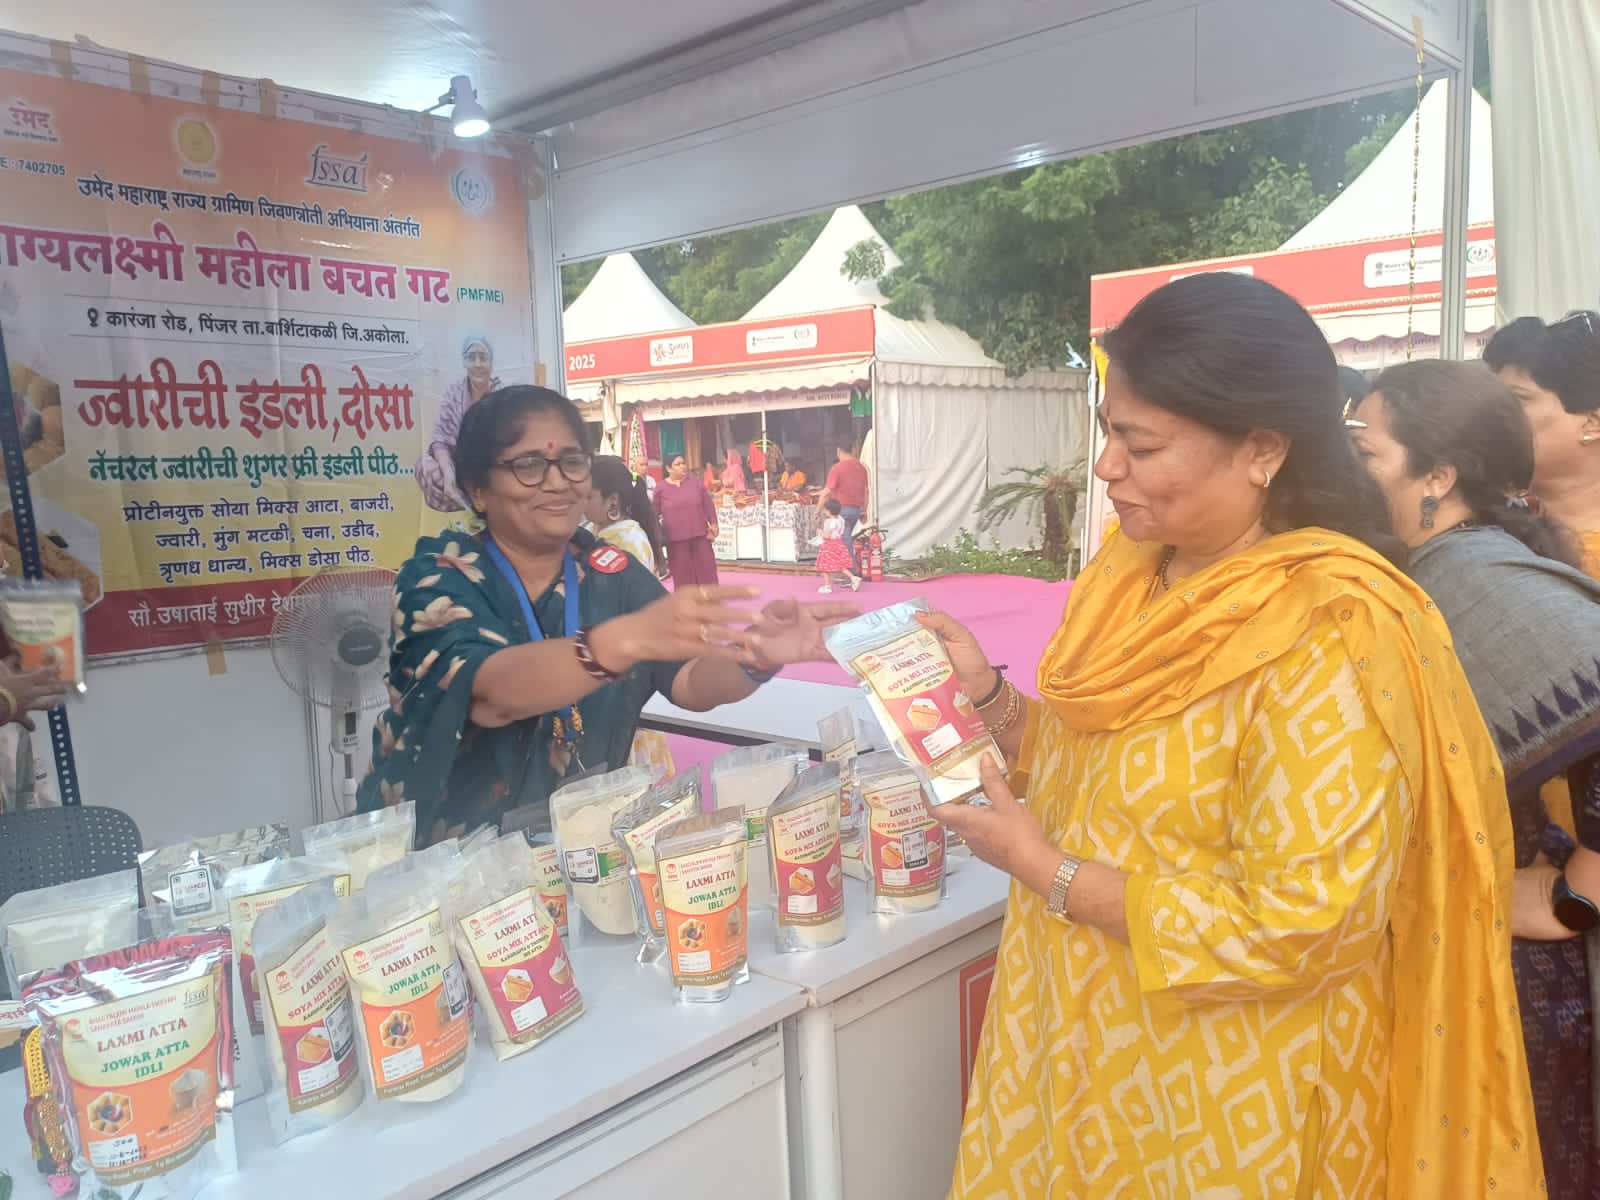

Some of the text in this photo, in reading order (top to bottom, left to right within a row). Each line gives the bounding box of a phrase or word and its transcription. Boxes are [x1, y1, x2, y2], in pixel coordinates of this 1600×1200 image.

[18, 159, 66, 176] 7402705
[311, 145, 369, 189] fssai
[77, 174, 113, 201] उमेद
[118, 184, 170, 211] महाराष्ट्र
[172, 191, 207, 211] राज्य
[211, 193, 254, 216] ग्रामिण
[327, 209, 379, 233] अभियाना
[383, 214, 421, 238] अंतर्गत
[0, 222, 504, 305] ाग्यलक्ष्मी महीला बचत गट (PMFME)
[106, 307, 156, 329] कारंजा
[161, 309, 193, 335] रोड,
[198, 313, 237, 335] पिंजर
[342, 321, 409, 345] जि.अकोला.
[569, 353, 596, 371] 2025
[73, 357, 414, 443] ज्वारीची इडली,दोसा
[161, 446, 238, 480] ज्वारीची
[242, 453, 287, 488] शुगर
[321, 446, 364, 480] इडली
[123, 492, 394, 525] प्रोटीनयुक्त सोया मिक्स आटा, बाजरी,
[155, 520, 380, 551] ज्वारी, मुंग मटकी, चना, उडीद,
[208, 558, 253, 573] धान्य,
[260, 551, 302, 569] मिक्स
[307, 547, 340, 566] डोसा
[346, 545, 374, 563] पीठ.
[224, 592, 266, 625] सुधीर
[888, 678, 910, 692] SOYA
[795, 827, 815, 840] LAXMI
[686, 870, 736, 889] LAXMI ATTA
[688, 885, 737, 905] JOWAR ATTA
[708, 900, 724, 911] IDLI
[495, 921, 521, 940] LAXMI
[381, 945, 437, 977] LAXMI ATTA
[487, 946, 509, 961] SOYA
[389, 962, 441, 994] JOWAR ATTA
[411, 981, 429, 997] IDLI
[288, 1001, 313, 1020] SOYA
[97, 1017, 188, 1053] LAXMI ATTA
[101, 1039, 190, 1073] JOWAR ATTA
[135, 1062, 164, 1078] IDLI
